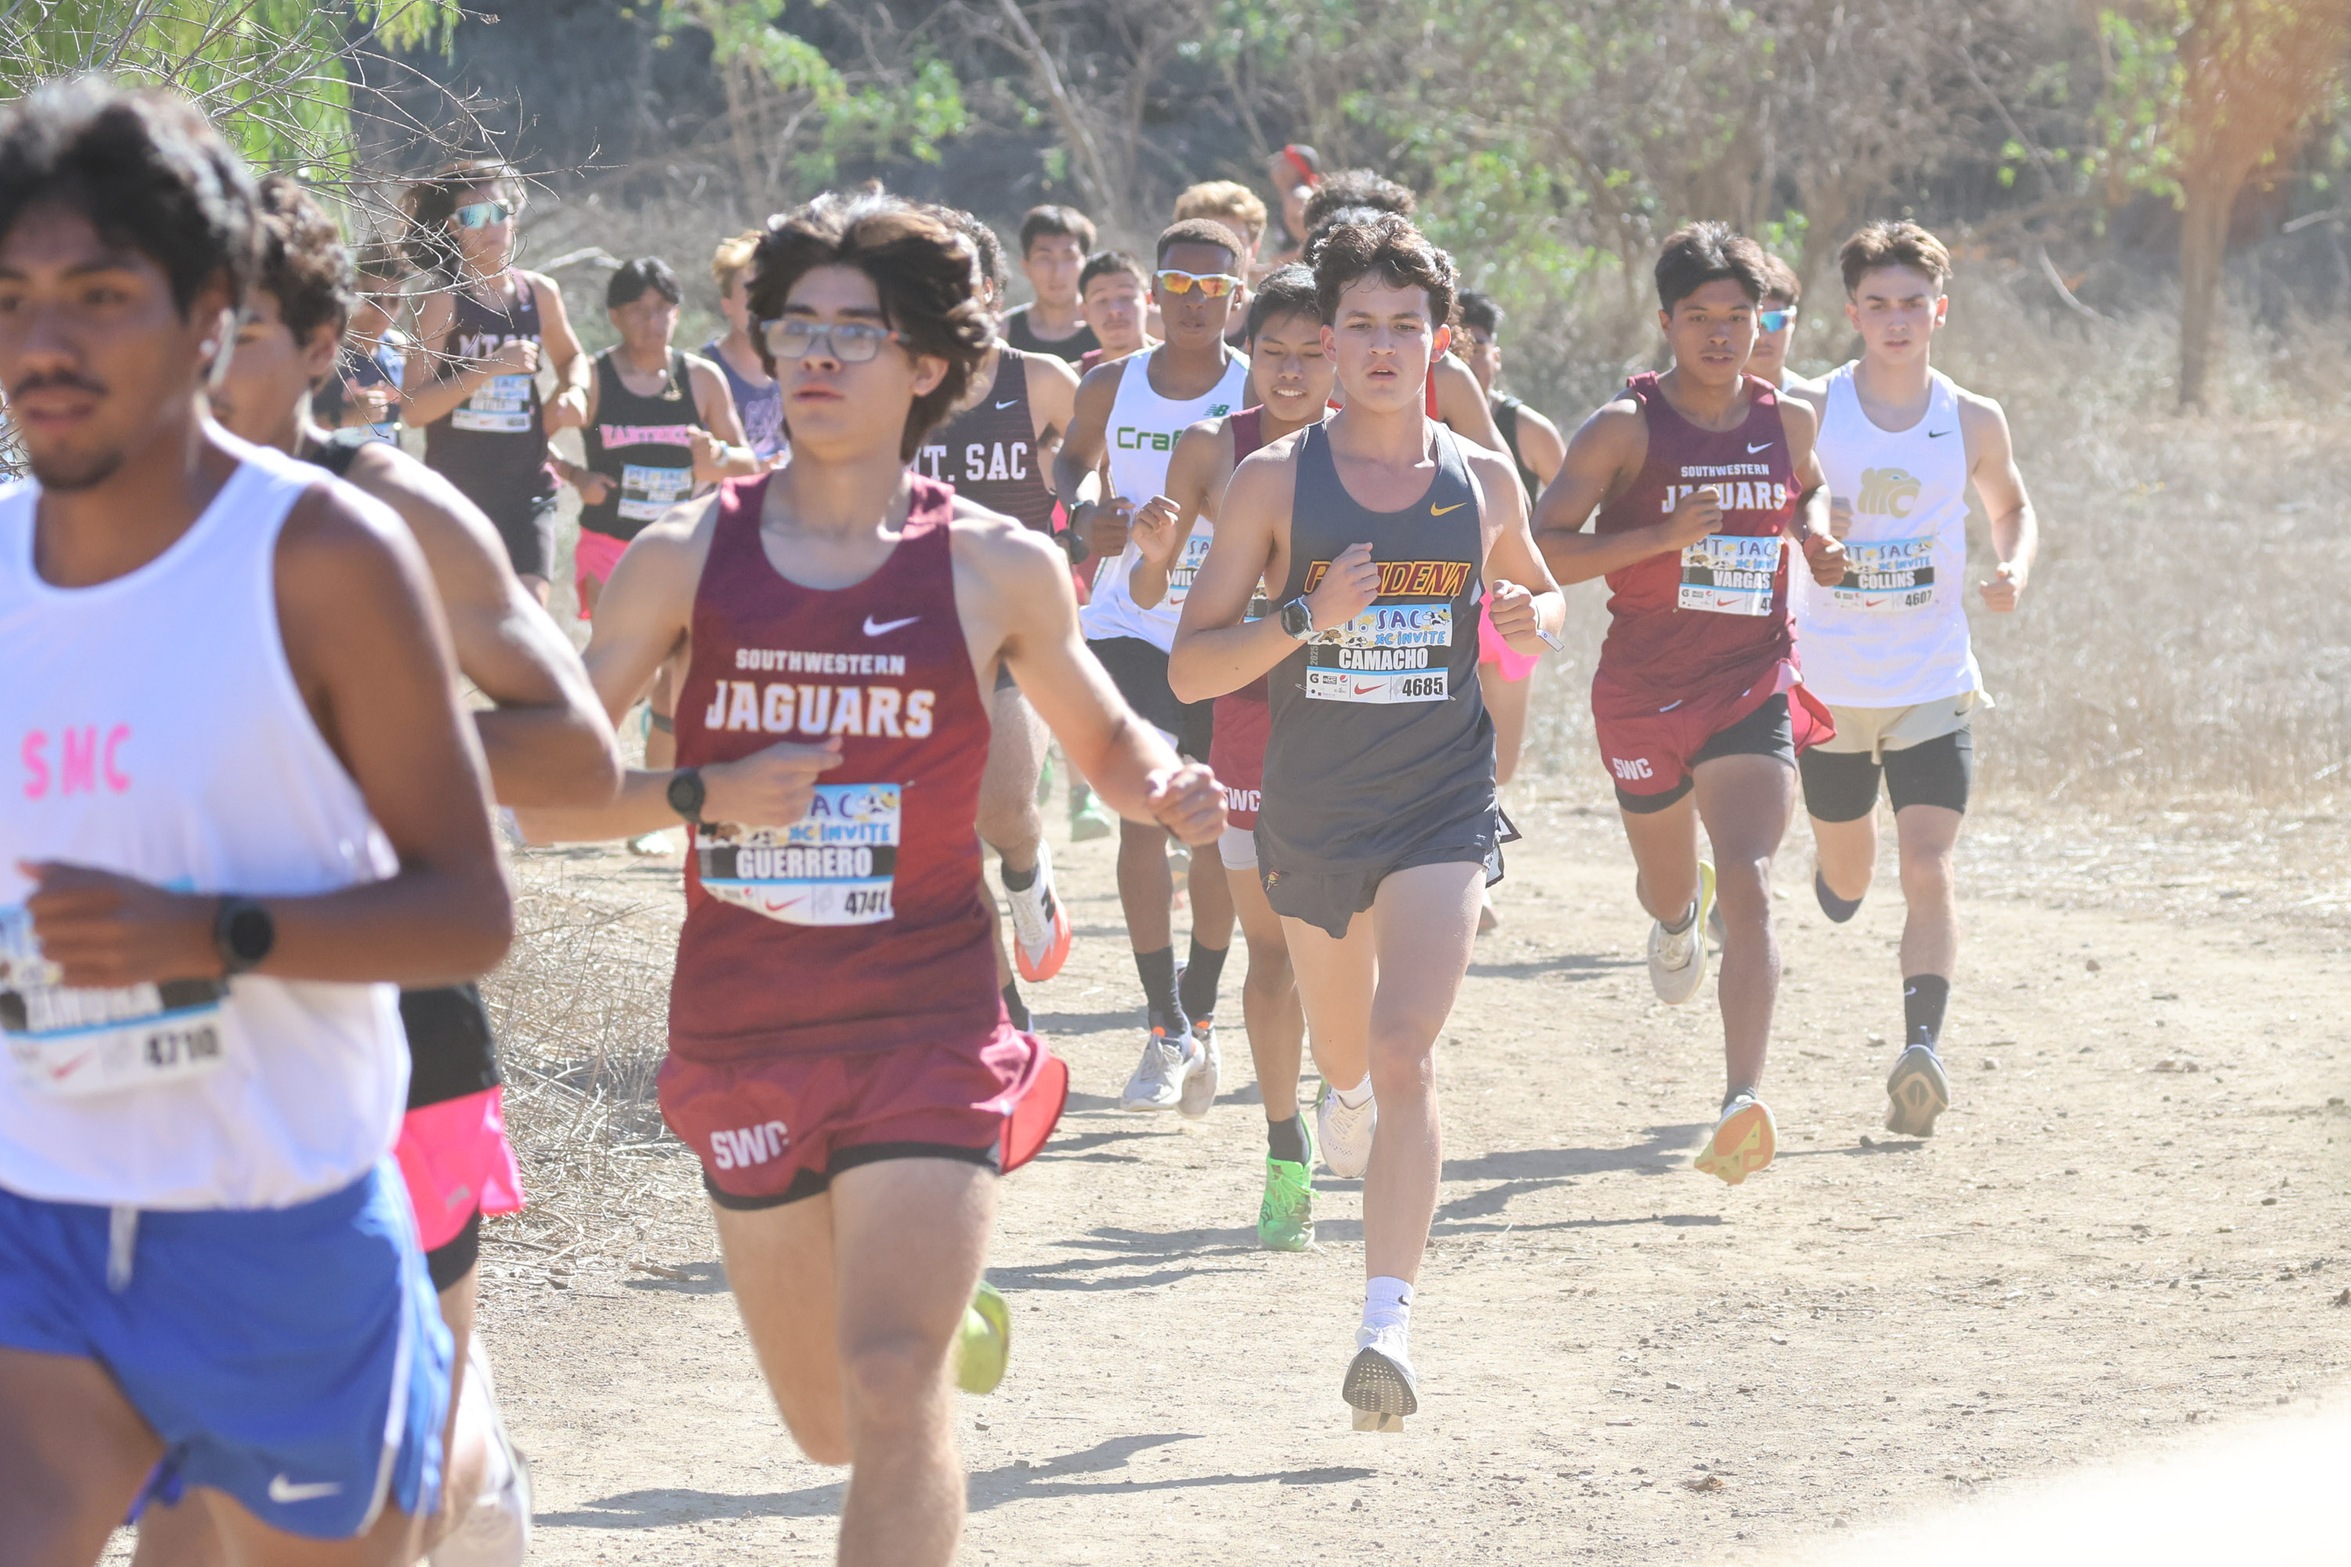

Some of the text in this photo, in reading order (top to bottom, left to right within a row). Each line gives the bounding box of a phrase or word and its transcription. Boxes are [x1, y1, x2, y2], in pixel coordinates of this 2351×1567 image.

[966, 442, 1028, 481] SAC
[1681, 464, 1769, 477] SOUTHWESTERN
[1713, 570, 1771, 589] VARGAS
[1858, 571, 1916, 590] COLLINS
[1905, 590, 1933, 607] 4607
[1377, 609, 1421, 630] SAC
[1374, 633, 1395, 646] XC
[735, 648, 906, 676] SOUTHWESTERN
[1338, 648, 1429, 671] CAMACHO
[1310, 673, 1319, 684] G
[1402, 677, 1444, 697] 4685
[704, 679, 936, 739] JAGUARS
[21, 723, 133, 800] SMC
[1612, 757, 1654, 780] SWC
[810, 793, 854, 819] AC
[736, 846, 874, 880] GUERRERO
[844, 889, 887, 916] 4741
[144, 1024, 220, 1067] 4710
